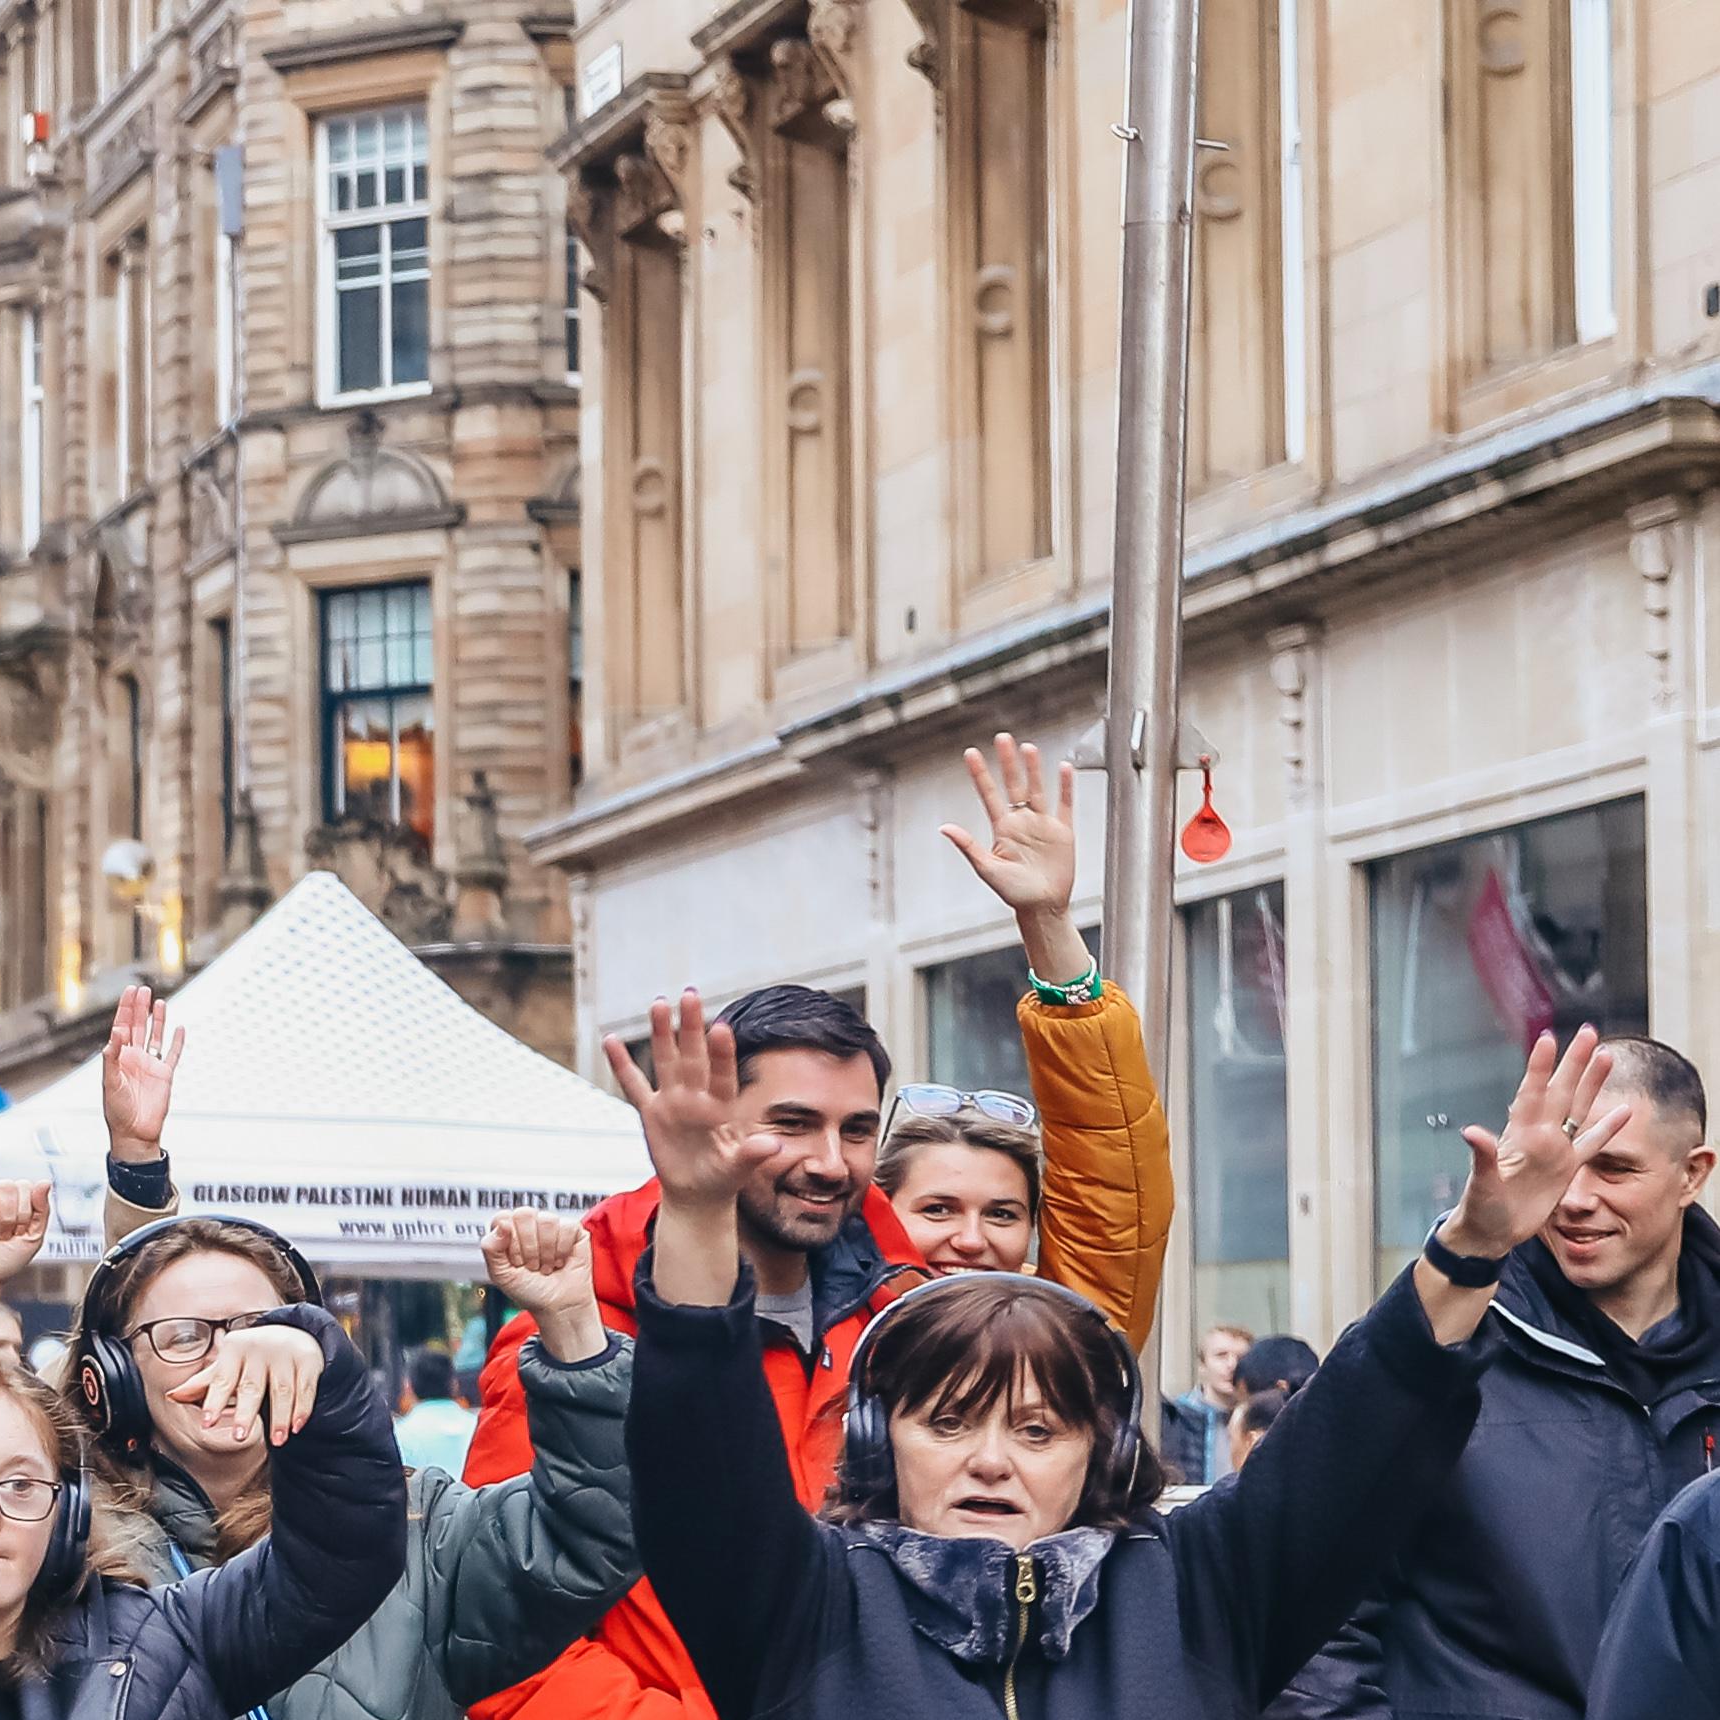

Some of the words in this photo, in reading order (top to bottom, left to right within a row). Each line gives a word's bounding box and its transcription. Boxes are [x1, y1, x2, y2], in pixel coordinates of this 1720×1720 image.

[193, 1184, 291, 1204] GLASGOW
[296, 1186, 393, 1206] PALESTINE
[401, 1187, 471, 1208] HUMAN
[477, 1190, 549, 1210] RIGHTS
